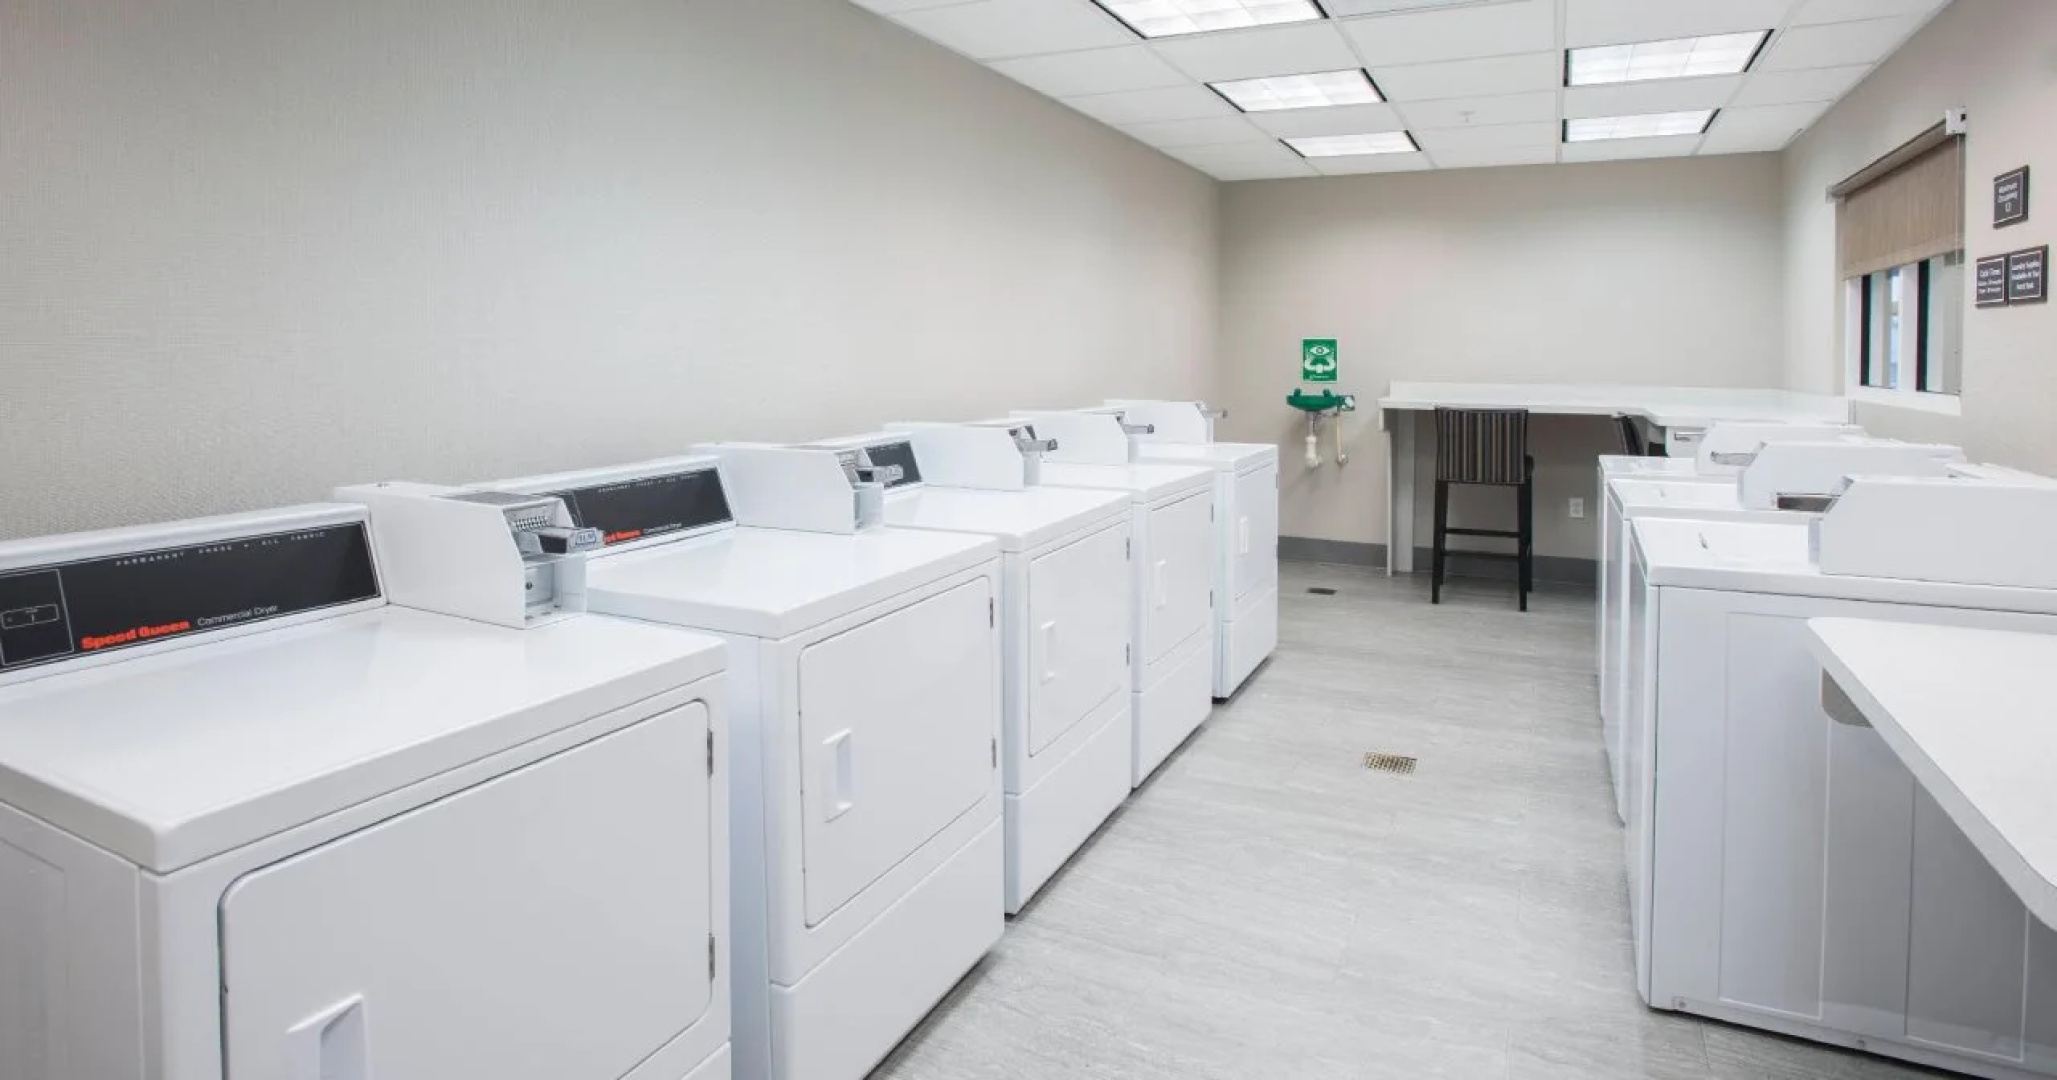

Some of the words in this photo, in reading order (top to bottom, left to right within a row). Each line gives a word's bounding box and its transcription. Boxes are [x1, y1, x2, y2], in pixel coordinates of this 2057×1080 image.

[80, 628, 137, 650] Speed
[138, 619, 192, 639] Queen
[197, 607, 252, 627] Commercial
[253, 603, 279, 616] Dryer
